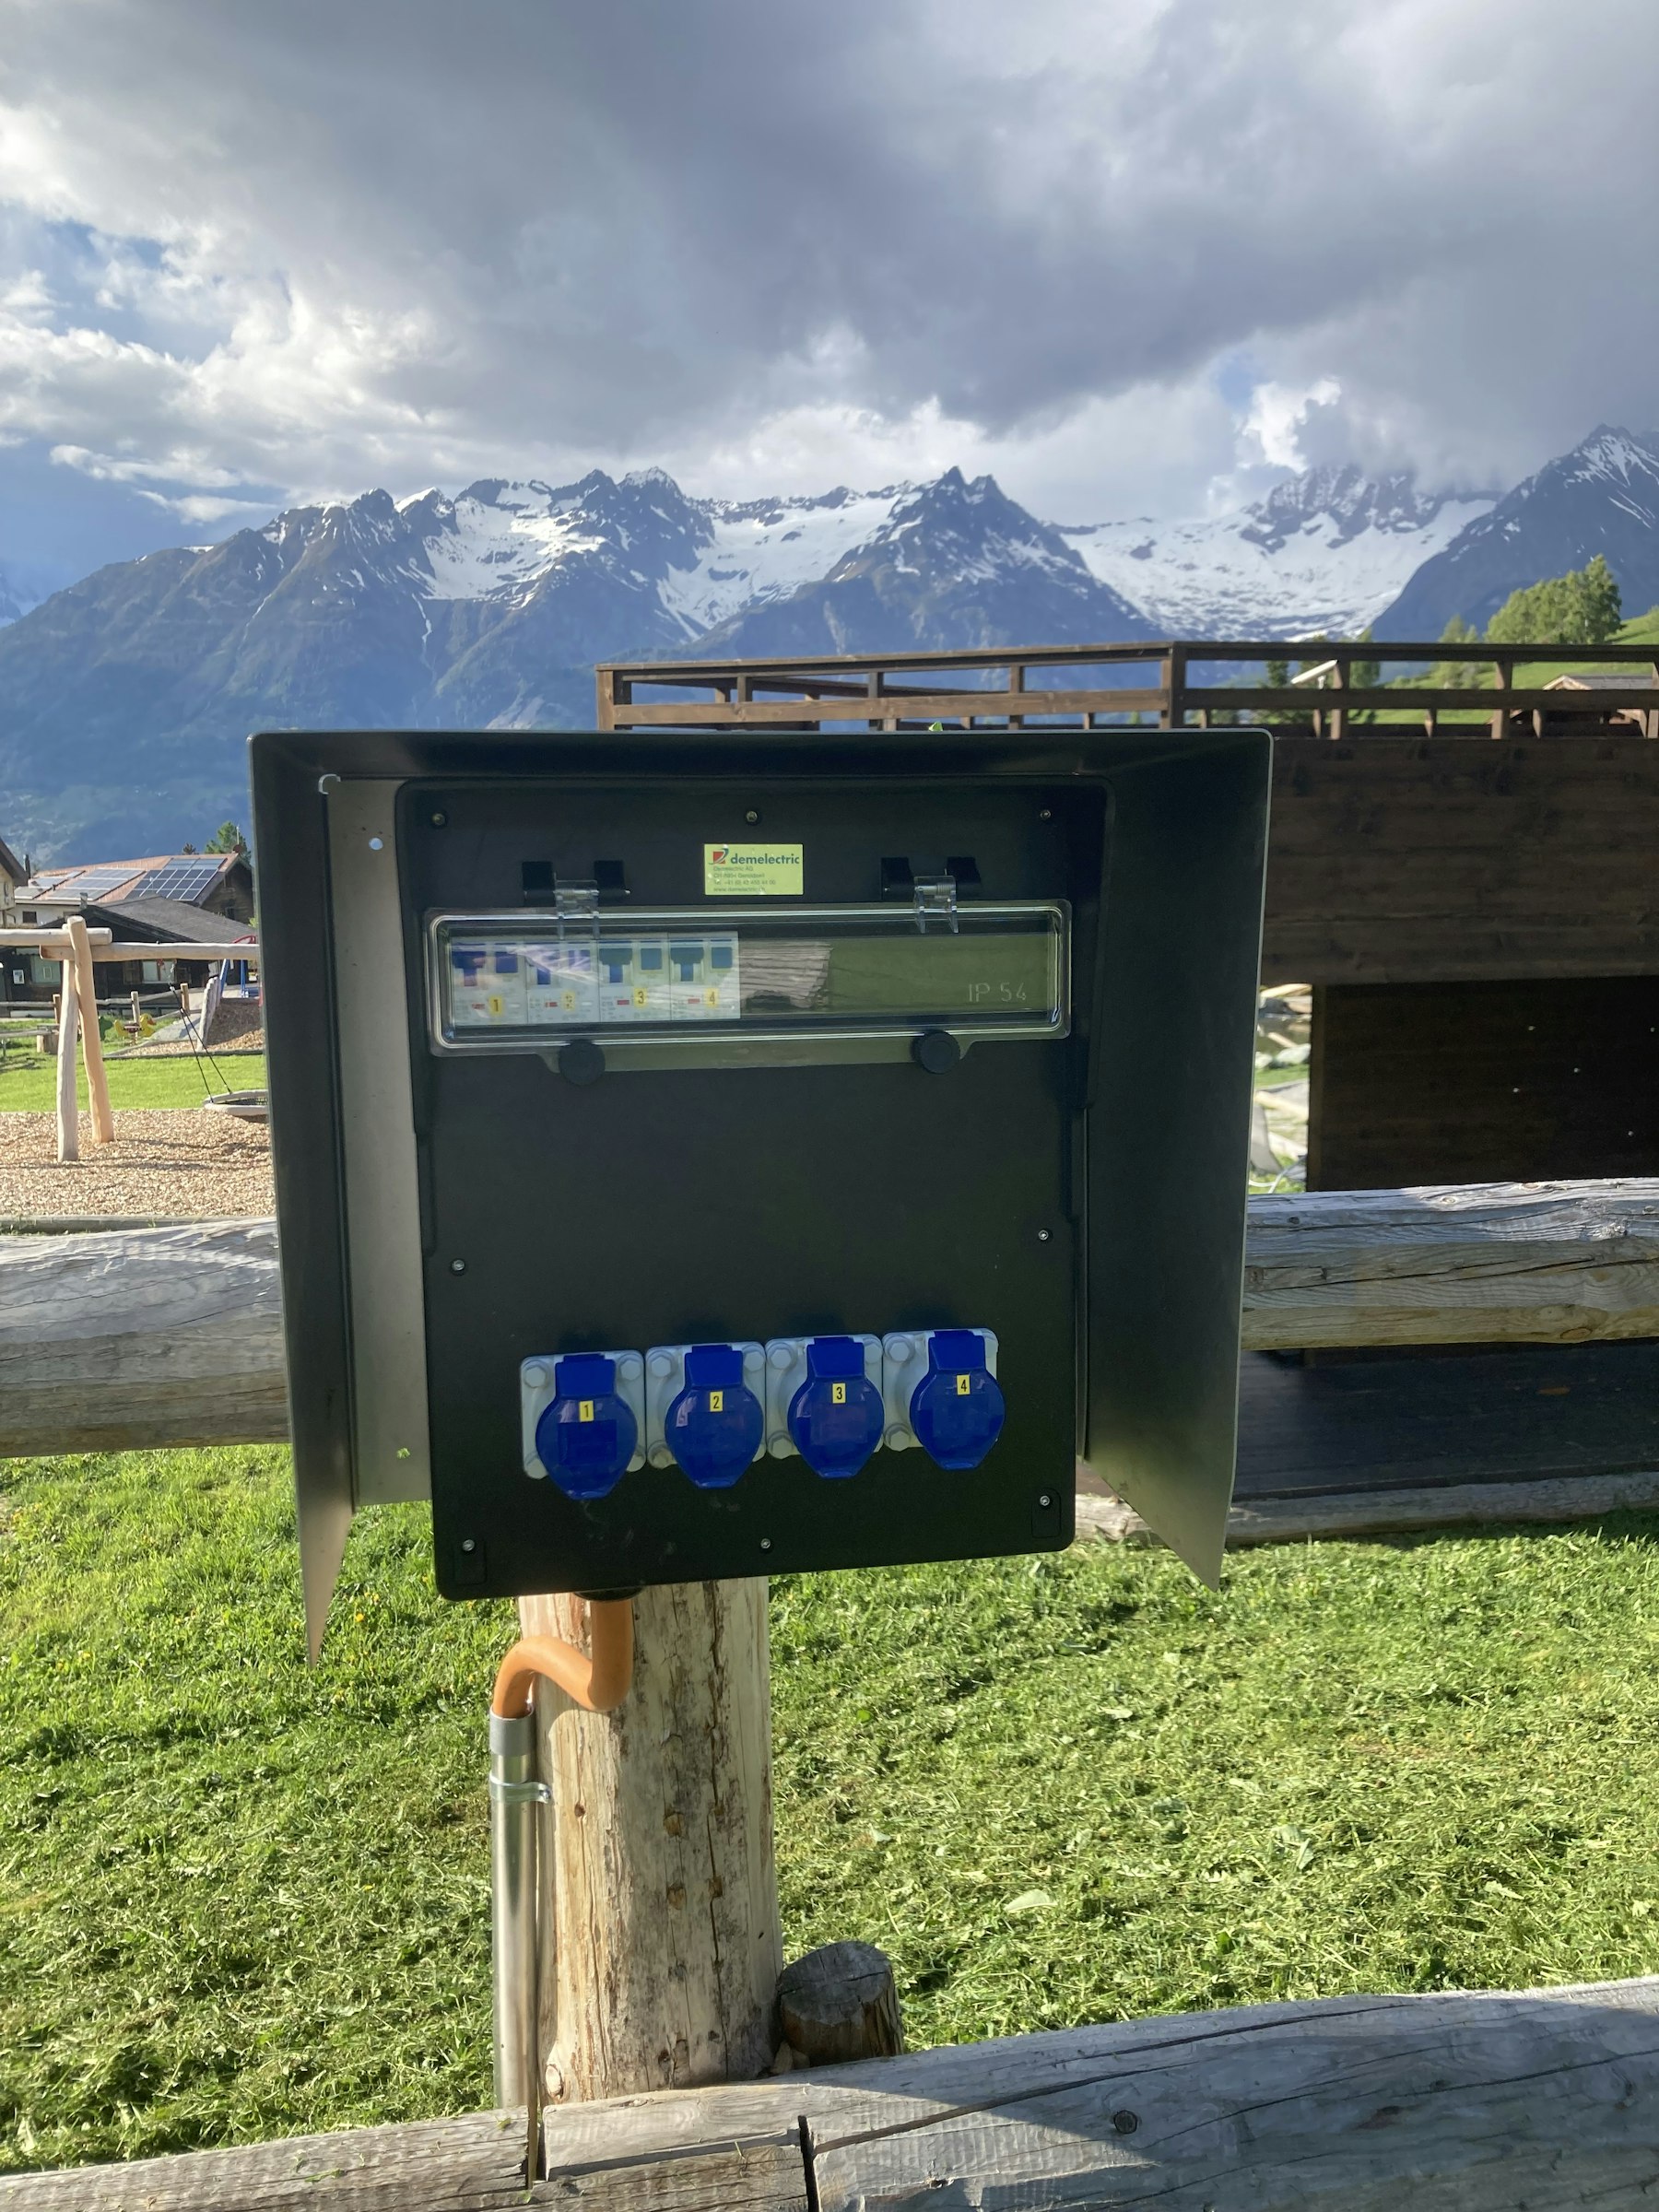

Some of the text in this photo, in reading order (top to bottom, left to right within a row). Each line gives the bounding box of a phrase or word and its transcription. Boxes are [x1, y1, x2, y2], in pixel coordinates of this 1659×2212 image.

[731, 853, 799, 865] demelectric
[637, 991, 644, 1005] 3
[709, 992, 715, 1005] 4
[969, 982, 1027, 1003] IP 54
[493, 998, 499, 1012] 1
[836, 1386, 842, 1400] 3
[960, 1379, 968, 1393] 4
[712, 1395, 720, 1409] 2
[583, 1405, 589, 1418] 1
